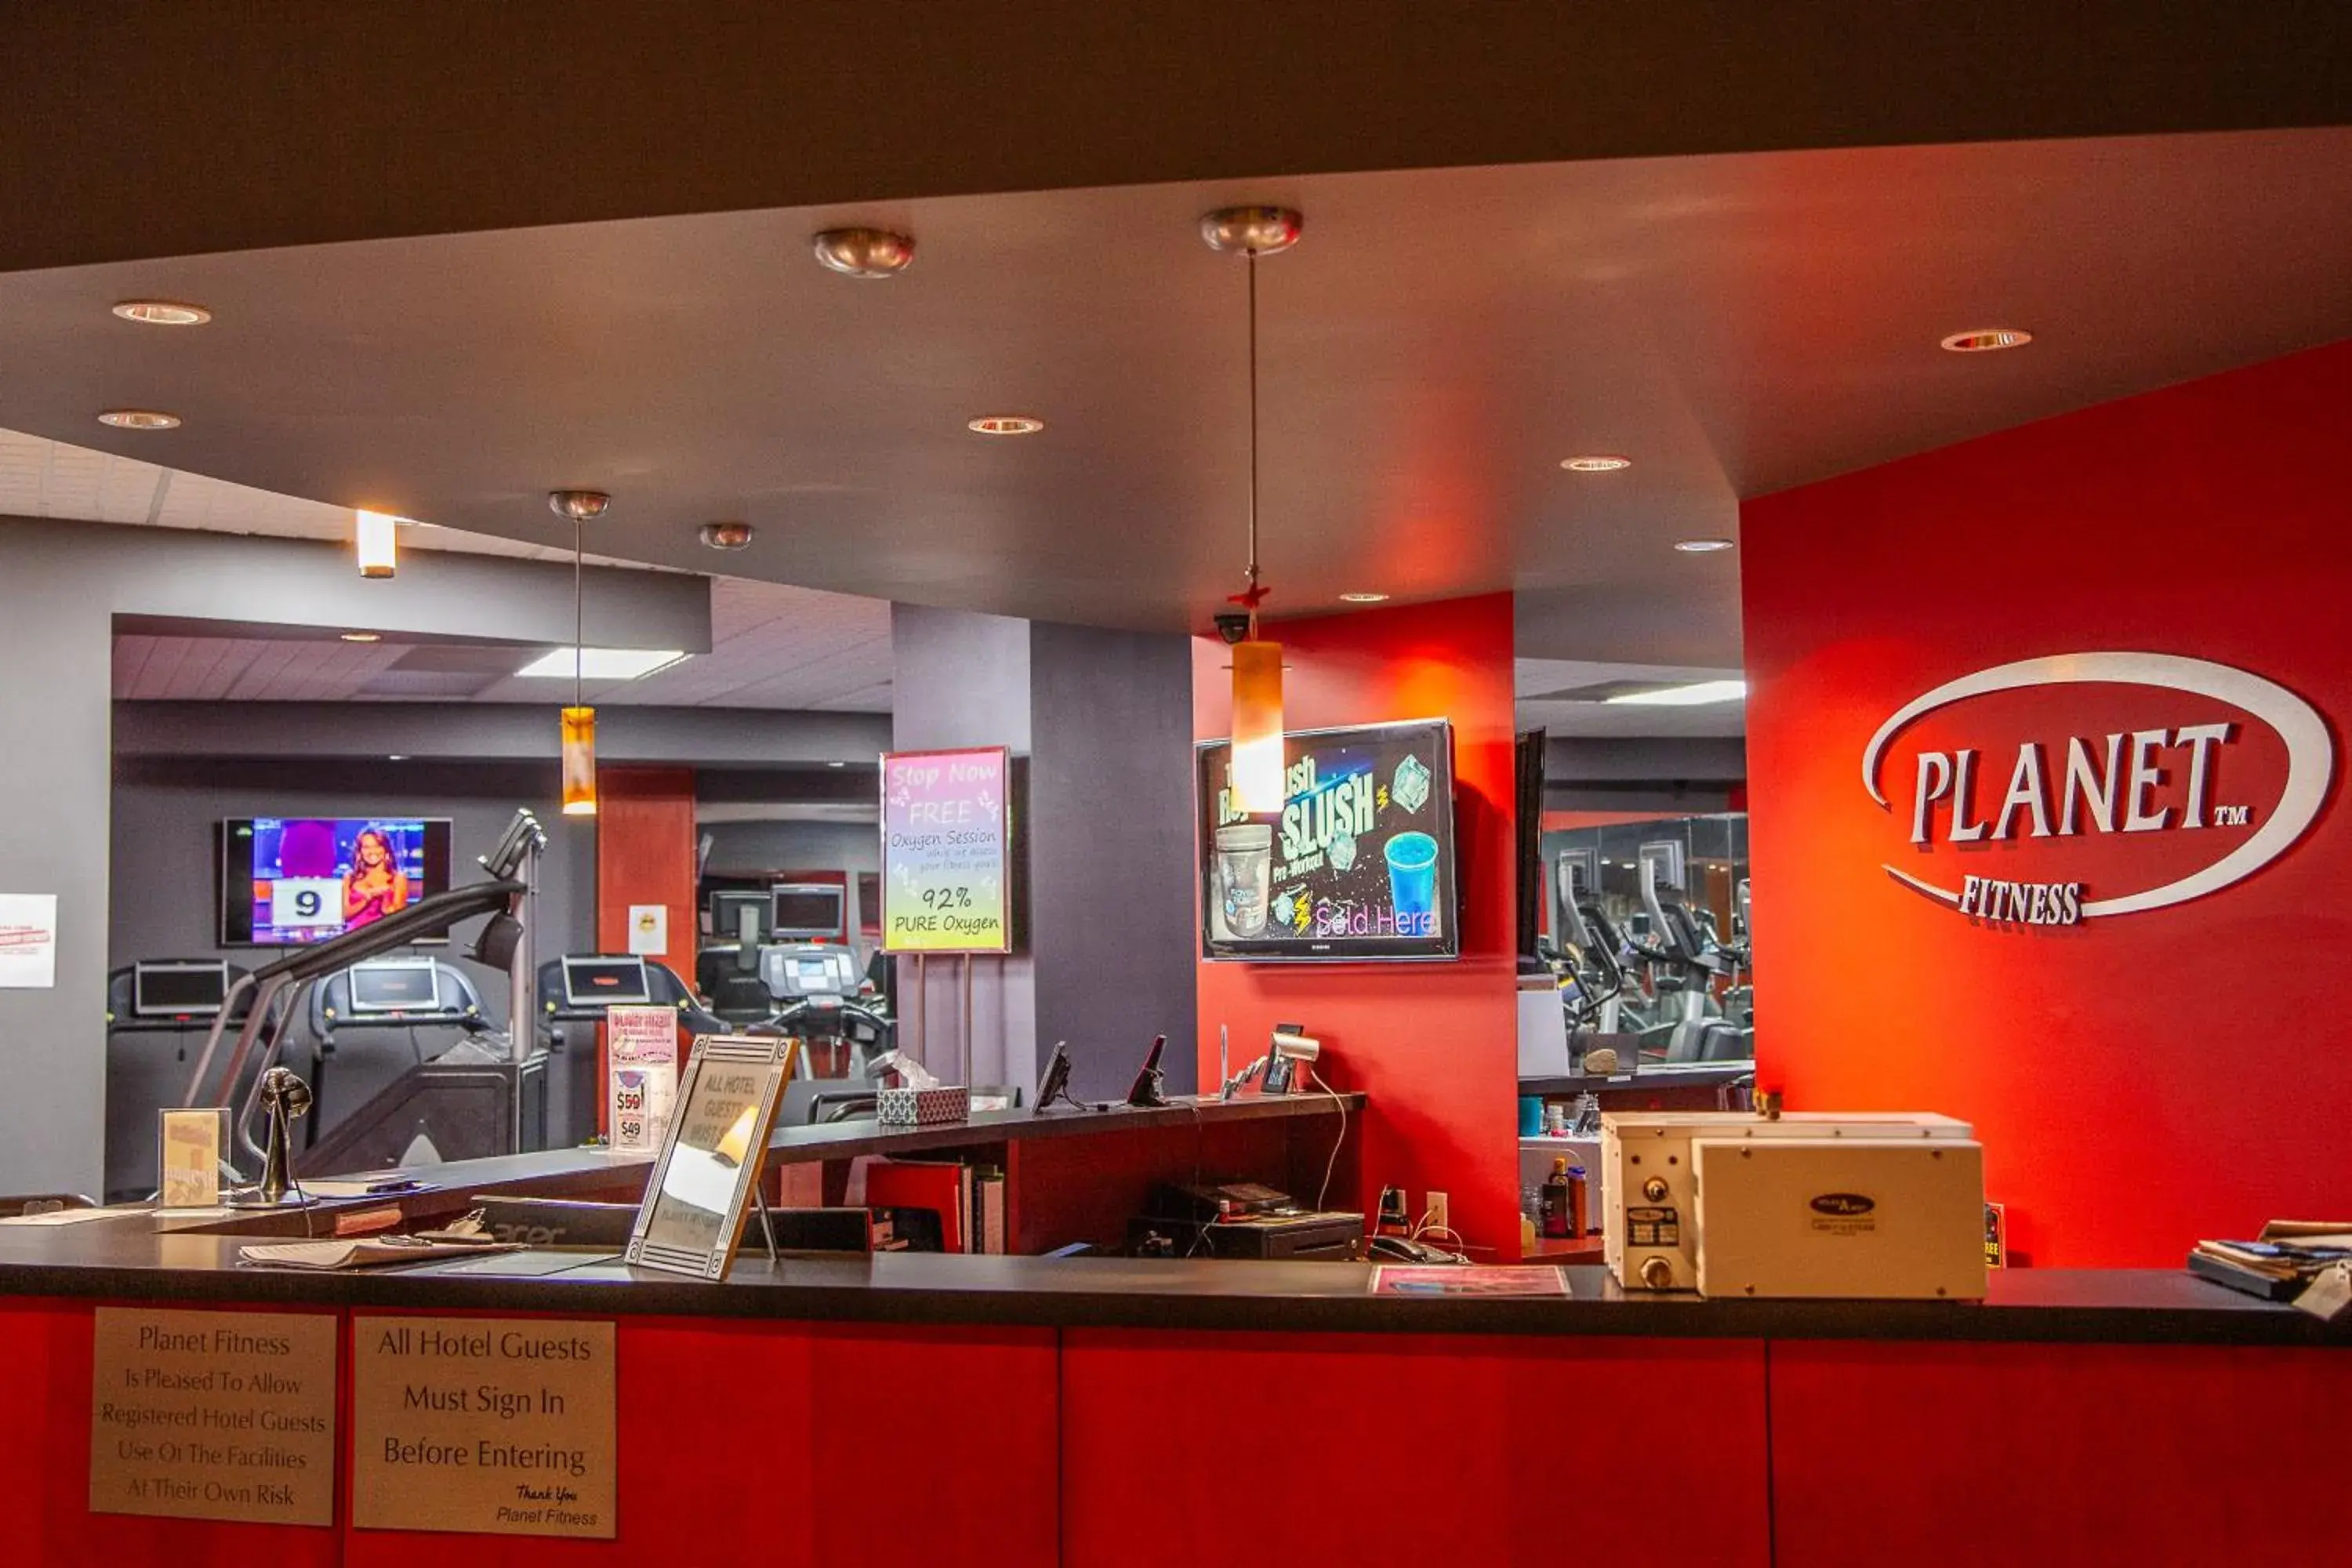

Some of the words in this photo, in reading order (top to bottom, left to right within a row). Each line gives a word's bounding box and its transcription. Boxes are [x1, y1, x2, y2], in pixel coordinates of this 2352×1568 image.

[892, 765, 940, 791] Stop
[949, 763, 996, 782] Now
[1911, 723, 2230, 844] PLANET
[2215, 805, 2249, 826] TM
[910, 800, 972, 825] FREE
[1282, 773, 1374, 858] SLUSH
[891, 833, 942, 851] Oxygen
[946, 828, 996, 845] Session
[296, 890, 322, 916] 9
[923, 887, 971, 910] 92%
[1958, 875, 2082, 926] FITNESS
[895, 916, 938, 932] PURE
[944, 914, 999, 935] Oxygen
[1316, 905, 1368, 935] Sold
[1377, 906, 1435, 935] Here
[705, 1075, 723, 1092] ALL
[724, 1076, 756, 1094] HOTEL
[622, 1122, 641, 1136] $49
[494, 1223, 566, 1244] acer
[139, 1325, 208, 1352] Planet
[214, 1329, 291, 1356] Fitness
[378, 1328, 410, 1356] All
[420, 1330, 491, 1357] Hotel
[500, 1333, 591, 1360] Guests
[125, 1368, 140, 1387] Is
[144, 1369, 213, 1392] Pleased
[220, 1371, 243, 1392] To
[248, 1373, 301, 1395] Allow
[404, 1385, 468, 1412] Must
[477, 1385, 532, 1420] Sign
[541, 1388, 564, 1414] In
[101, 1403, 197, 1429] Registered
[203, 1408, 254, 1429] Hotel
[260, 1410, 325, 1433] Guests
[118, 1440, 154, 1461] Use
[189, 1443, 222, 1465] The
[227, 1445, 307, 1469] Facilities
[384, 1436, 468, 1465] Before
[478, 1440, 586, 1477] Entering
[127, 1478, 147, 1497] At
[150, 1478, 198, 1501] Their
[204, 1482, 251, 1503] Own
[256, 1484, 295, 1506] Risk
[516, 1482, 552, 1501] Thank
[555, 1486, 578, 1505] You
[496, 1507, 542, 1523] Planet
[545, 1509, 597, 1526] Fitness
